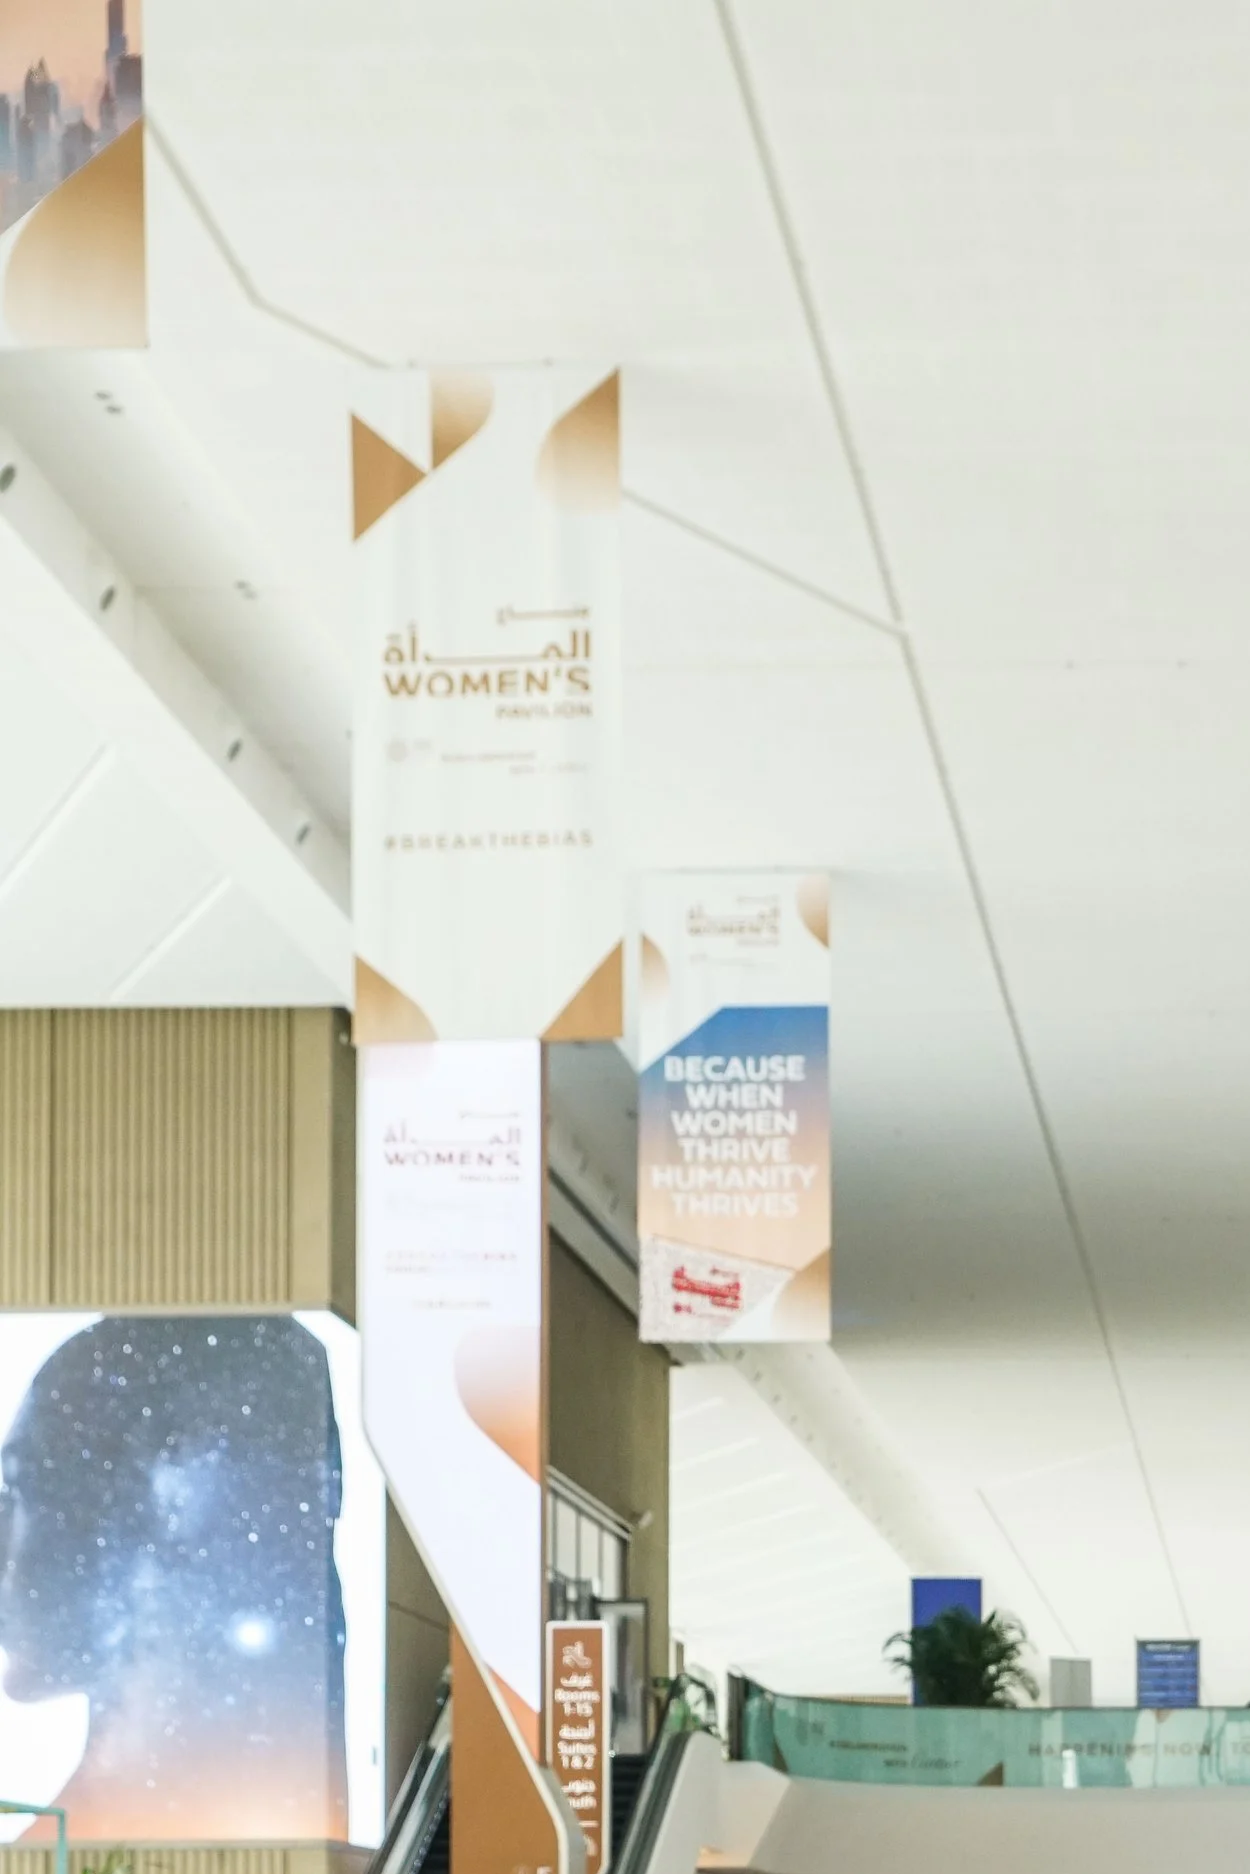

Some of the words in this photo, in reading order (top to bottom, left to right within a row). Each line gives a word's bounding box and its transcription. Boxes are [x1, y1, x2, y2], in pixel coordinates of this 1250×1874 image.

[382, 664, 592, 699] WOMEN'S
[495, 701, 593, 720] PAVILION
[664, 1055, 806, 1083] BECAUSE
[684, 1082, 784, 1109] WHEN
[670, 1109, 798, 1137] WOMEN
[384, 1149, 521, 1167] WOMEN'S
[678, 1137, 791, 1163] THRIVE
[652, 1163, 819, 1191] HUMANITY
[671, 1192, 800, 1218] THRIVES
[555, 1688, 600, 1703] Rooms
[557, 1740, 597, 1756] Suites
